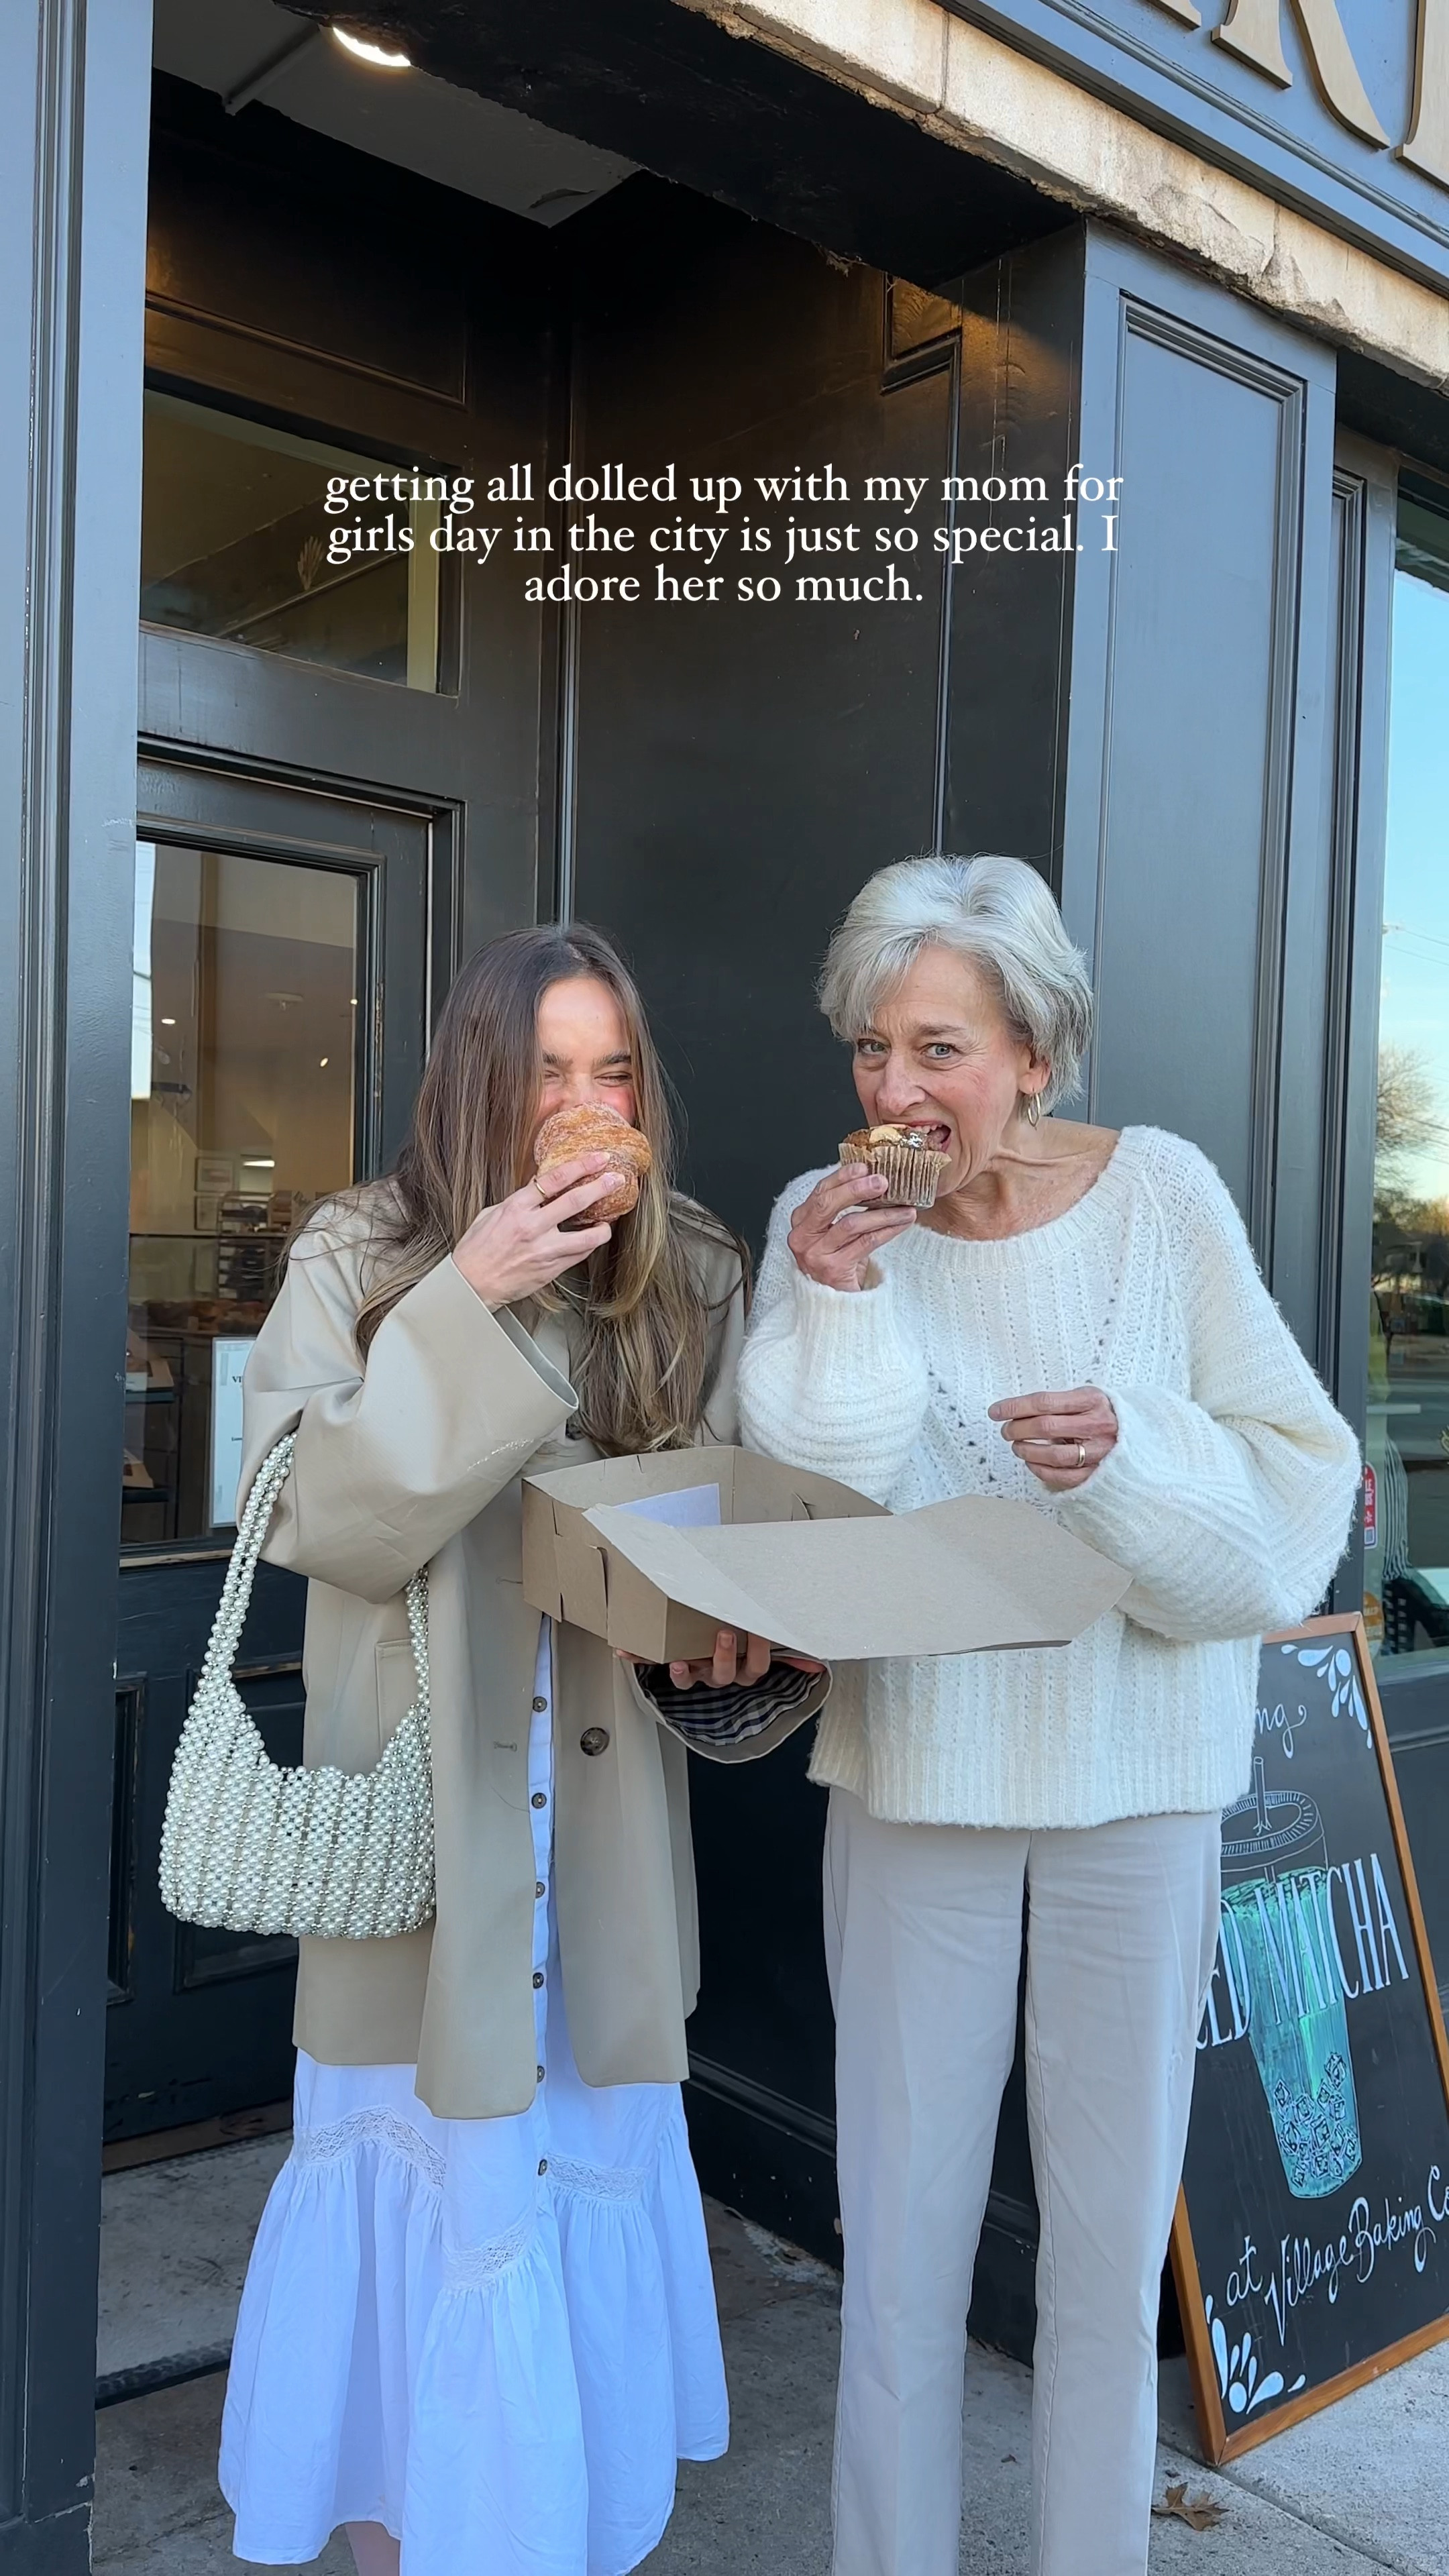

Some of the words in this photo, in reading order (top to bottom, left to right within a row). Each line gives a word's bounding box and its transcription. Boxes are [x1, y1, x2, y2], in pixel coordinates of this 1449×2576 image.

[1255, 1703, 1307, 1759] ng
[1253, 1853, 1409, 2026] MATCHA
[1226, 2235, 1264, 2306] at
[1264, 2234, 1354, 2347] Village
[1348, 2196, 1437, 2283] Baking
